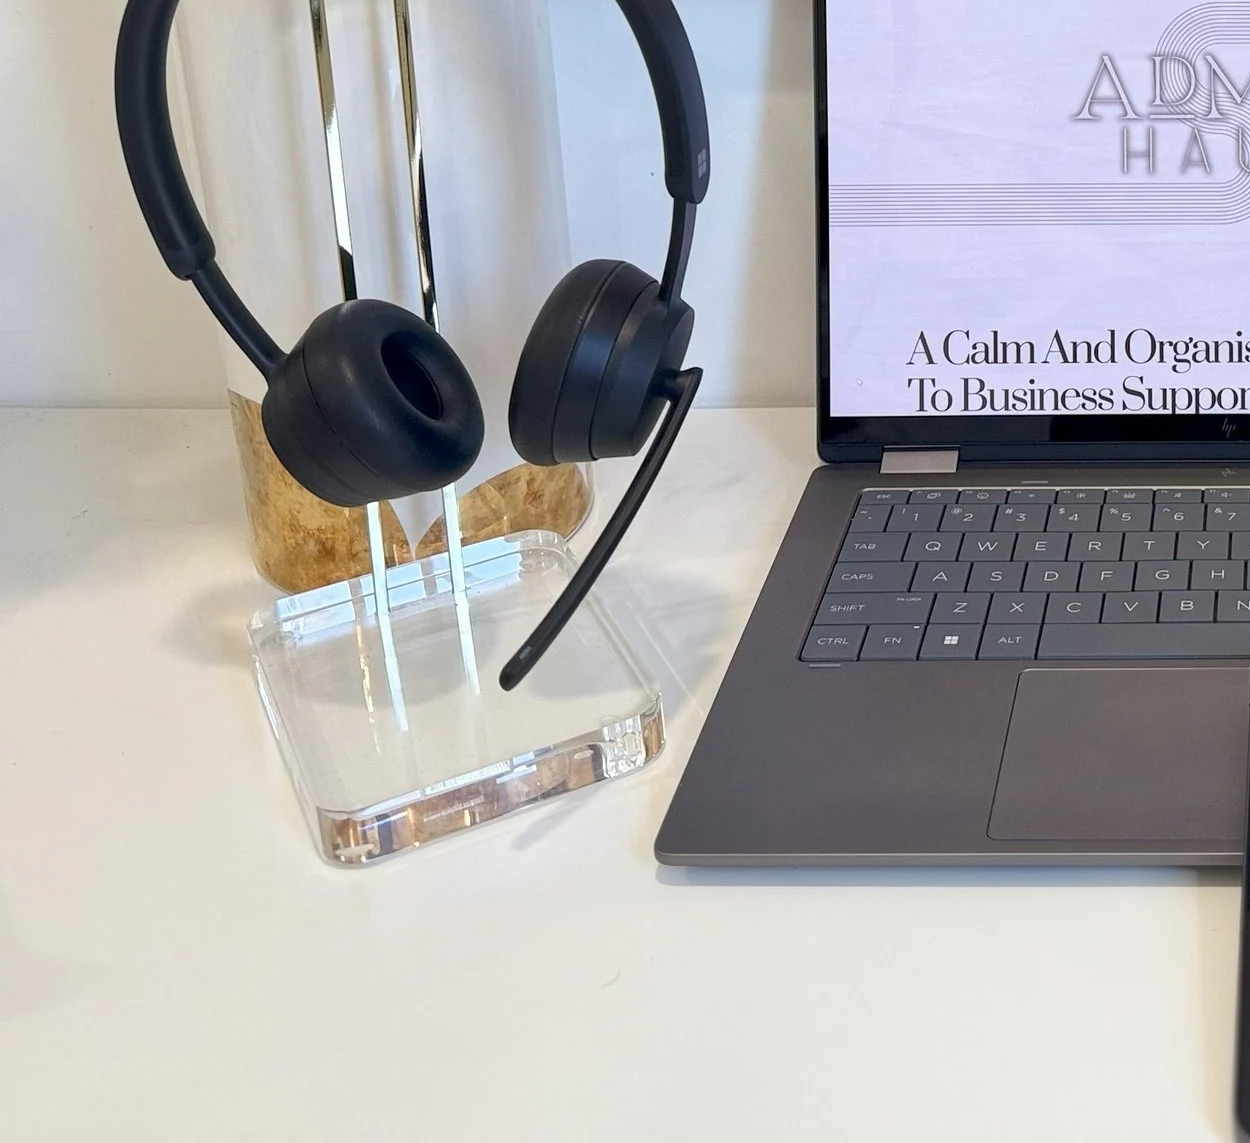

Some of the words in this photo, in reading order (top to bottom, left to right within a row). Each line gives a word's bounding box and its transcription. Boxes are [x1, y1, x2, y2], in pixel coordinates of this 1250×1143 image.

[906, 330, 938, 365] A
[942, 329, 1036, 365] Calm
[1040, 329, 1118, 364] And
[907, 377, 954, 412] To
[960, 377, 1115, 412] Business
[912, 512, 919, 522] 1
[962, 512, 974, 522] 2
[1016, 513, 1027, 522] 3
[1068, 513, 1079, 522] 4
[1121, 512, 1131, 522] 5
[1173, 512, 1184, 521] 6
[1227, 512, 1237, 521] 7
[925, 541, 942, 551] Q
[977, 541, 999, 552] W
[1034, 541, 1048, 551] E
[1088, 541, 1102, 551] R
[1143, 540, 1156, 551] T
[1196, 540, 1210, 550] Y
[932, 571, 948, 582] A
[990, 571, 1002, 582] S
[1043, 571, 1059, 582] D
[1100, 570, 1113, 581] F
[1155, 569, 1170, 580] G
[1211, 569, 1225, 580] H
[830, 604, 865, 612] SHIFT
[952, 602, 968, 613] Z
[1009, 602, 1025, 613] X
[1066, 602, 1082, 613] C
[1123, 601, 1139, 612] V
[1180, 600, 1194, 611] B
[817, 637, 849, 645] CTRL
[997, 636, 1022, 644] ALT
